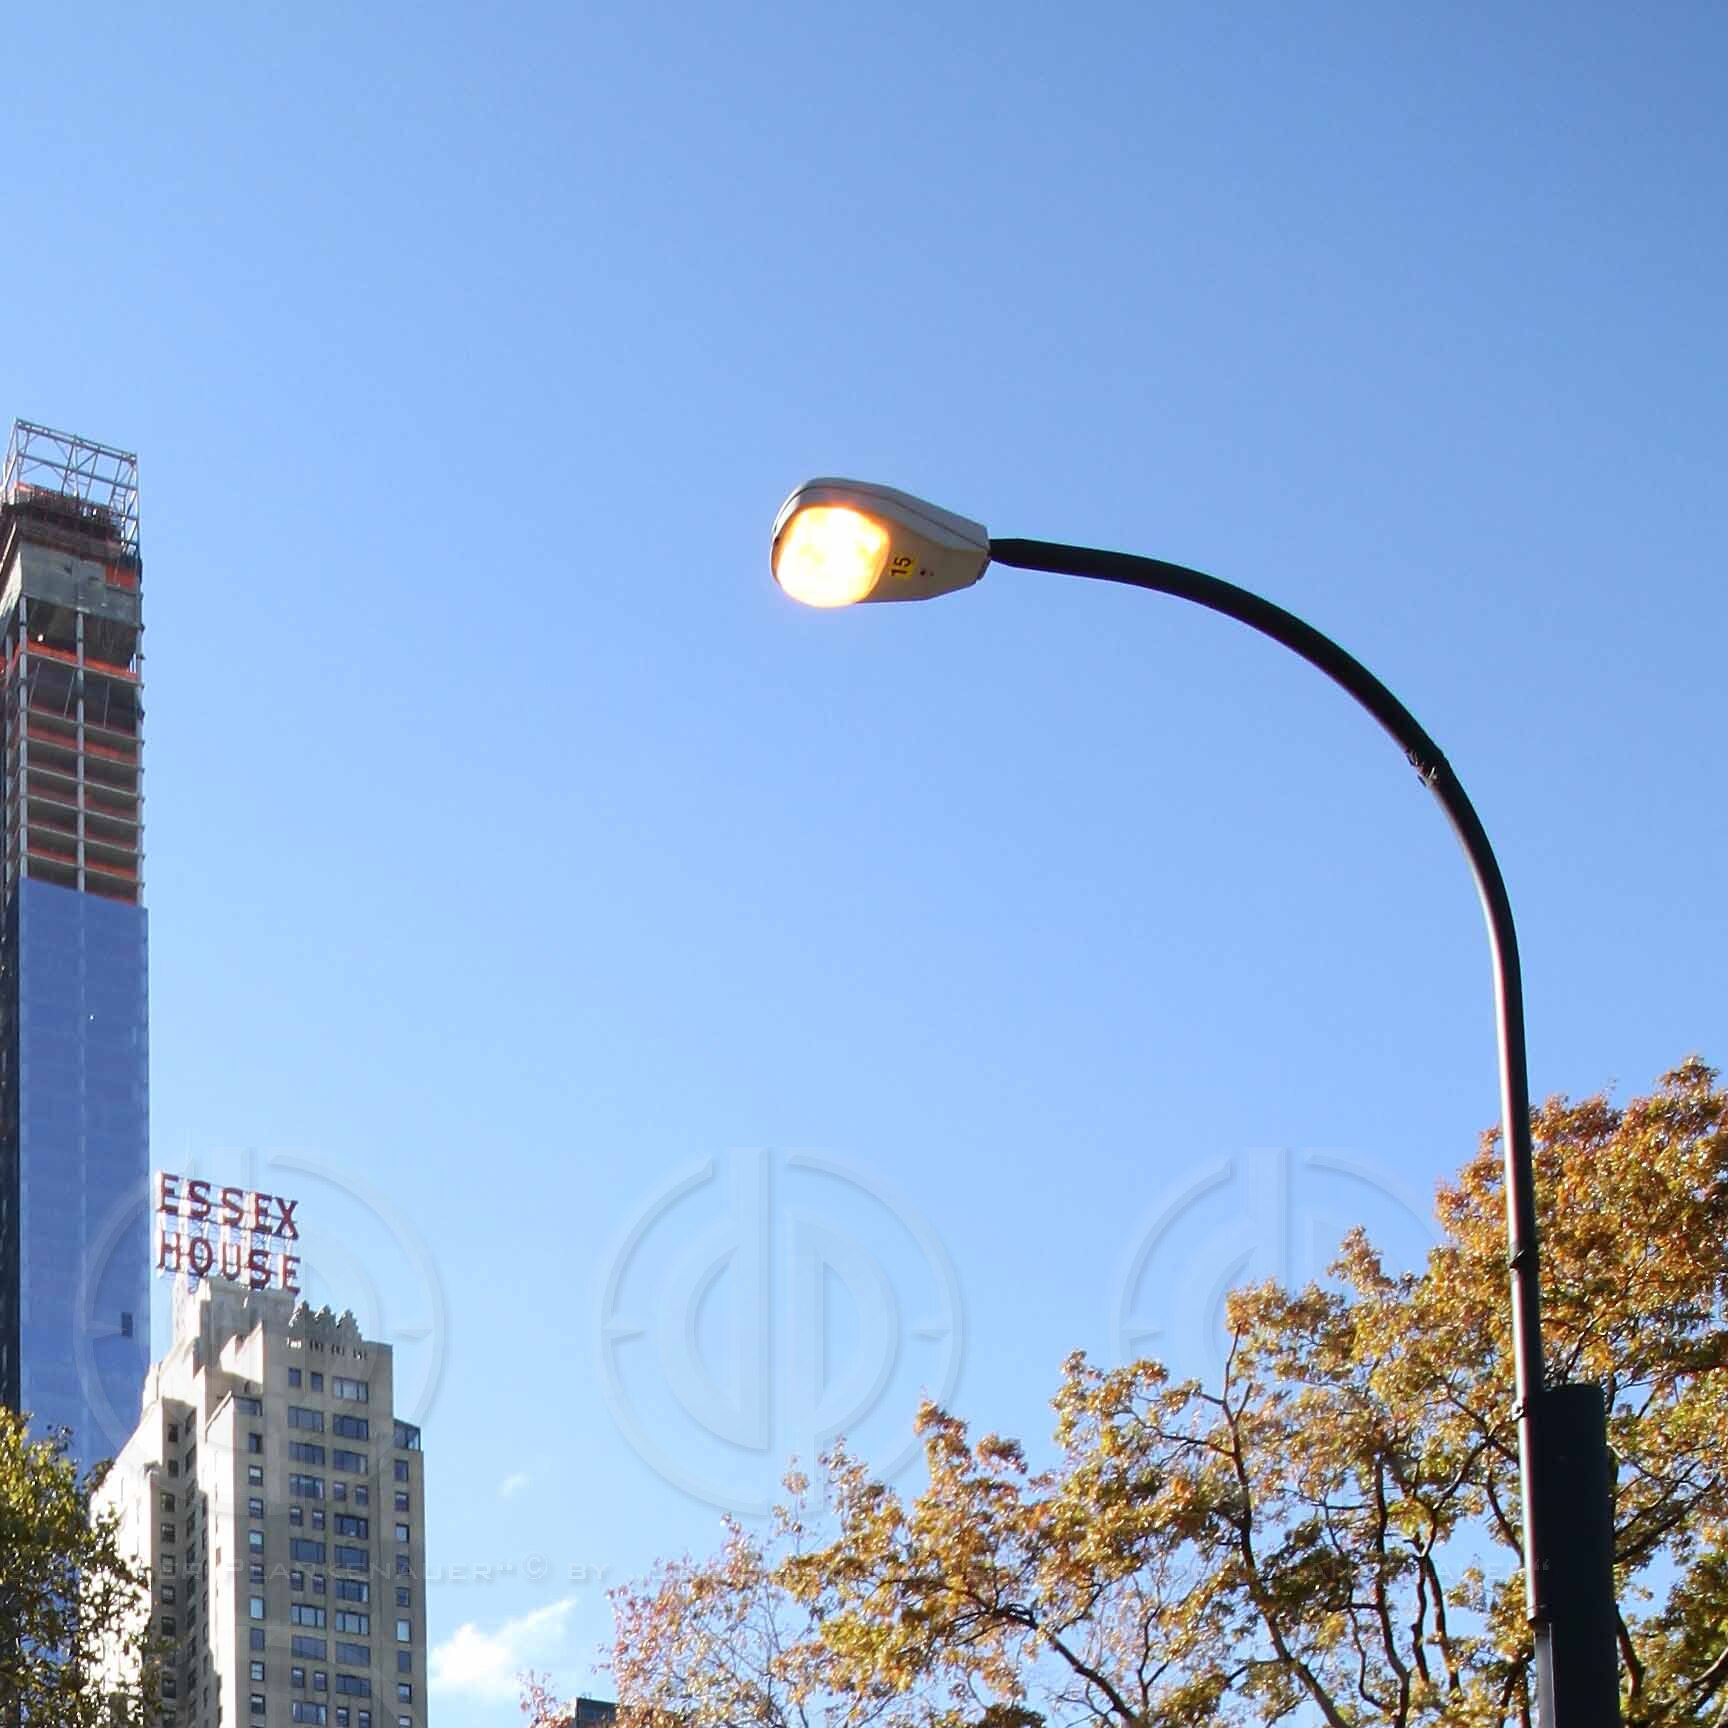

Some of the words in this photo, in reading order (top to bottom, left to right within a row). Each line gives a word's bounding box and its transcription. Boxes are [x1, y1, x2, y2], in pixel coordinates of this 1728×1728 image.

[890, 556, 913, 577] 15
[156, 1171, 299, 1240] ESSEX
[156, 1231, 301, 1294] HOUSE
